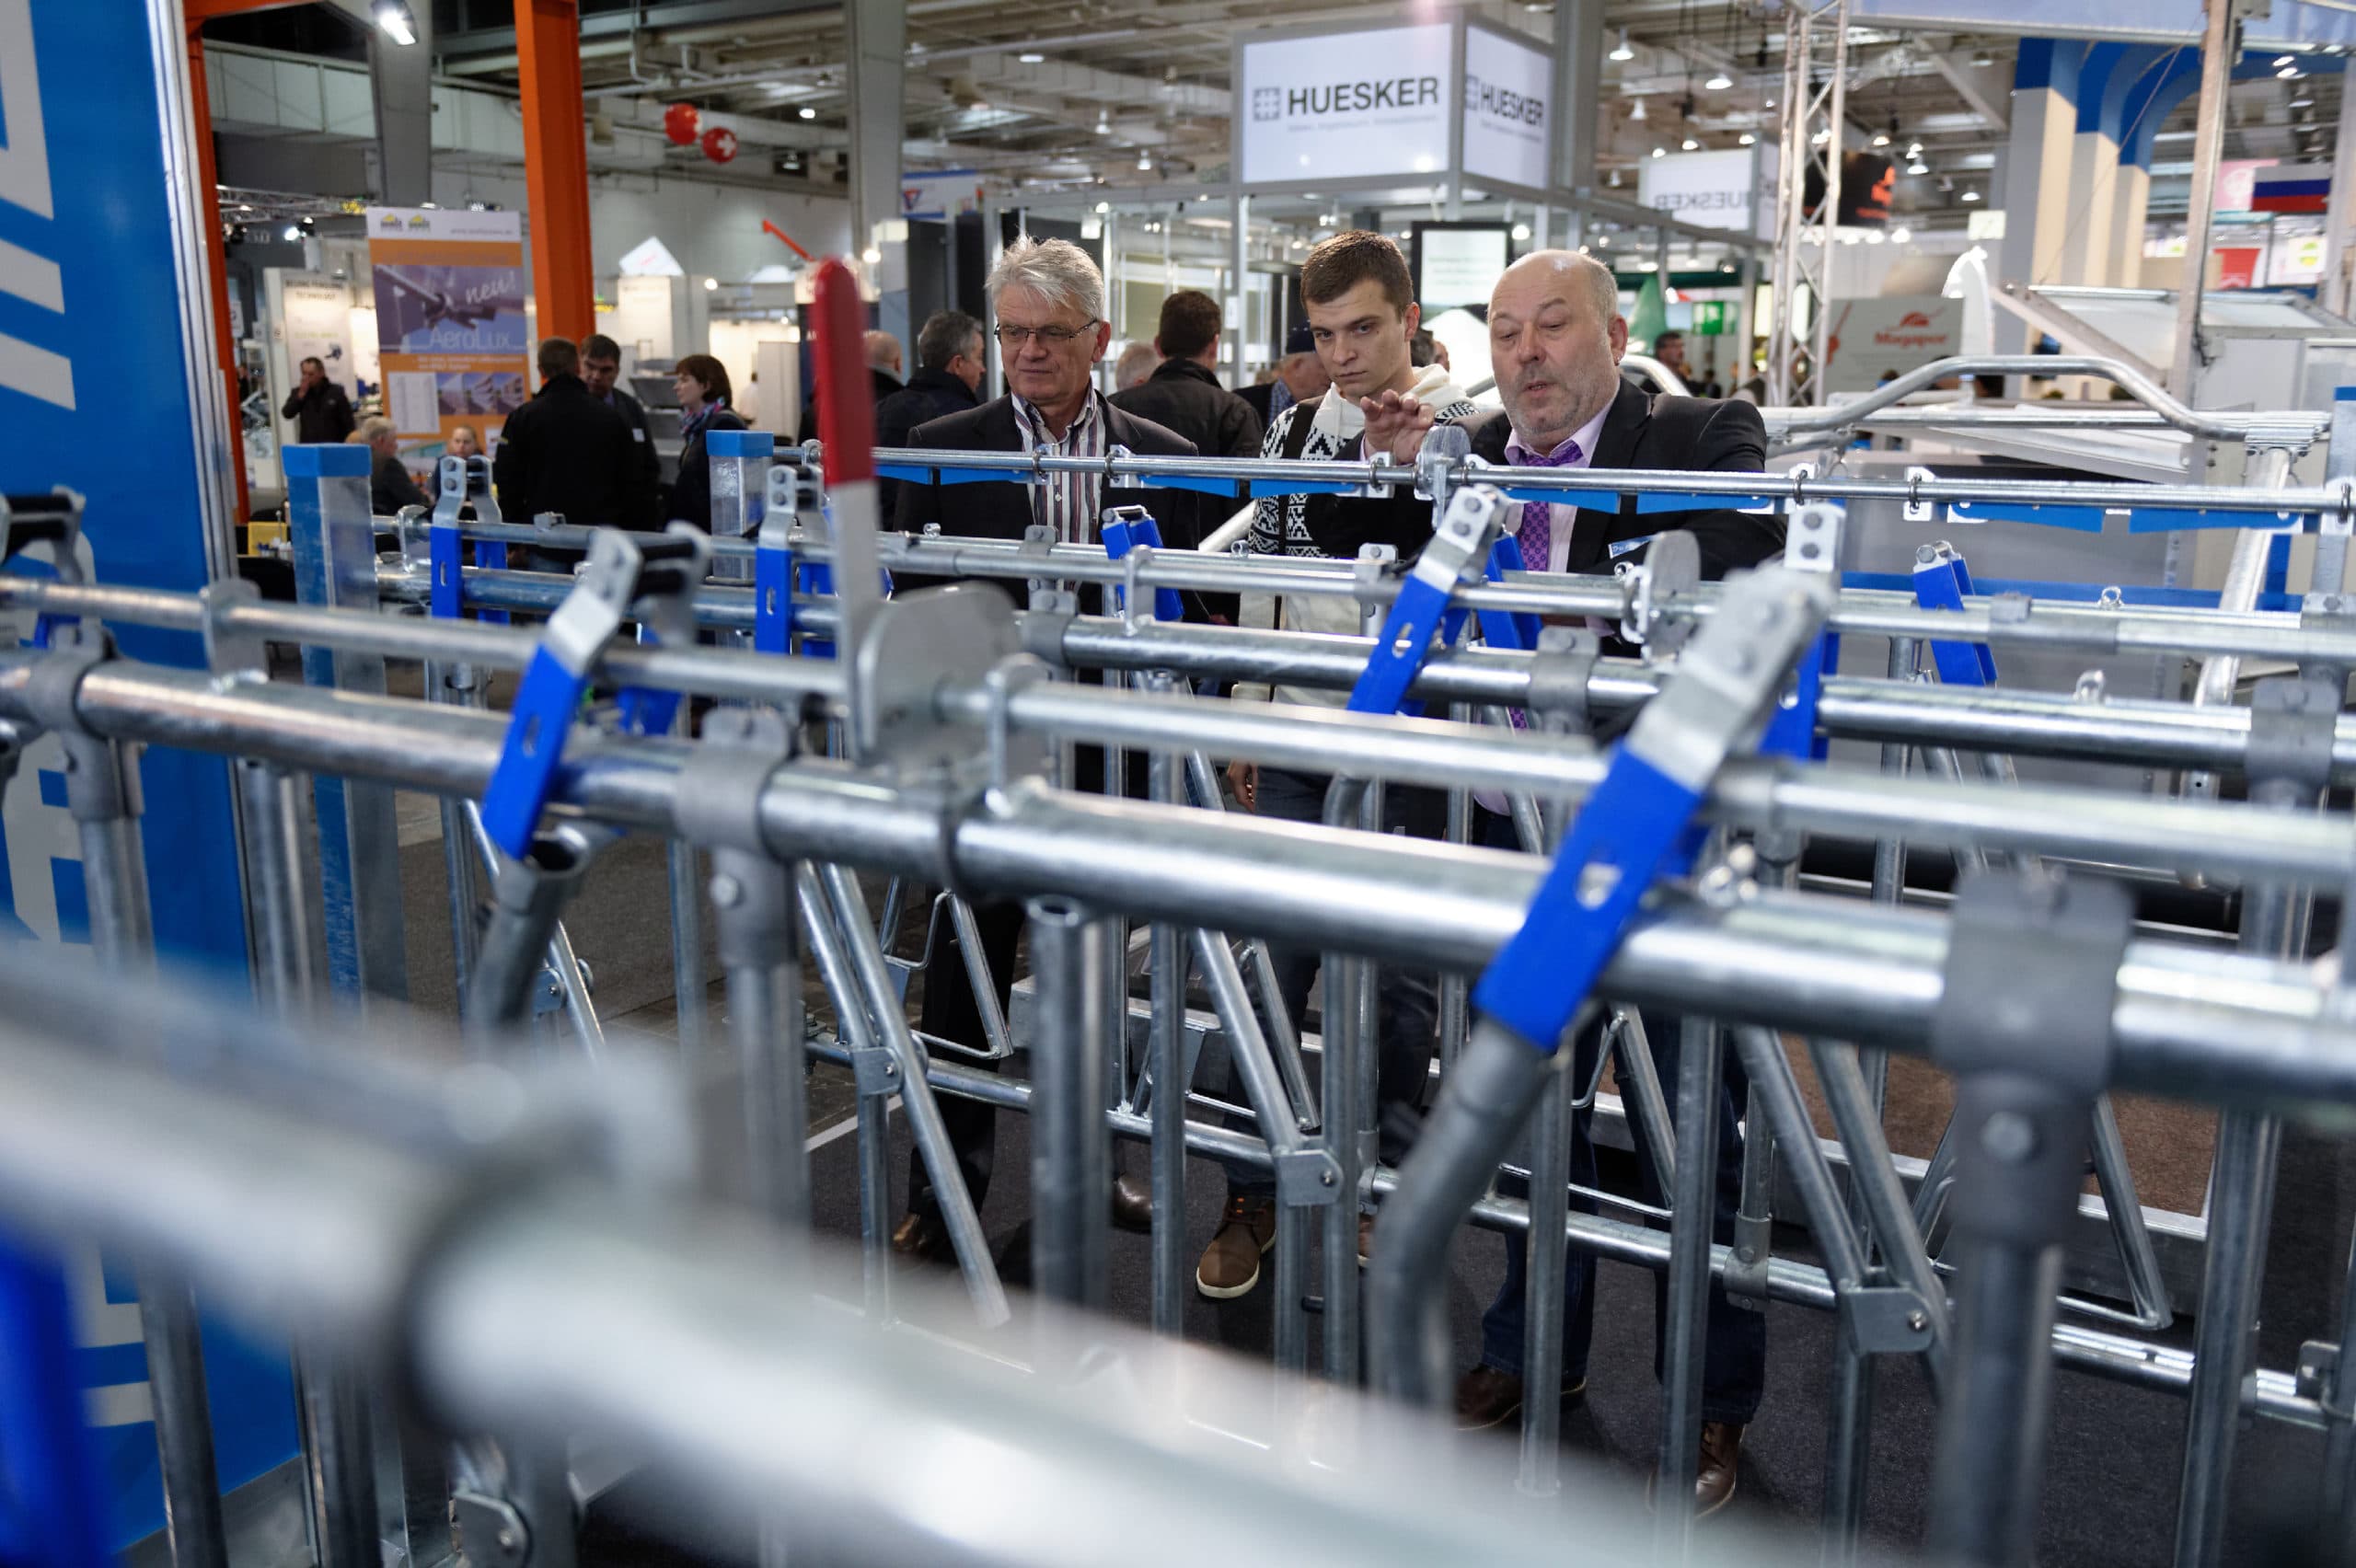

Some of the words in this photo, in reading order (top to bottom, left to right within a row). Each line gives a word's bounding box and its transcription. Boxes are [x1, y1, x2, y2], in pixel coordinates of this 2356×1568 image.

[1288, 76, 1439, 116] HUESKER
[1480, 83, 1544, 128] HUESKER
[430, 329, 510, 350] AeroLux
